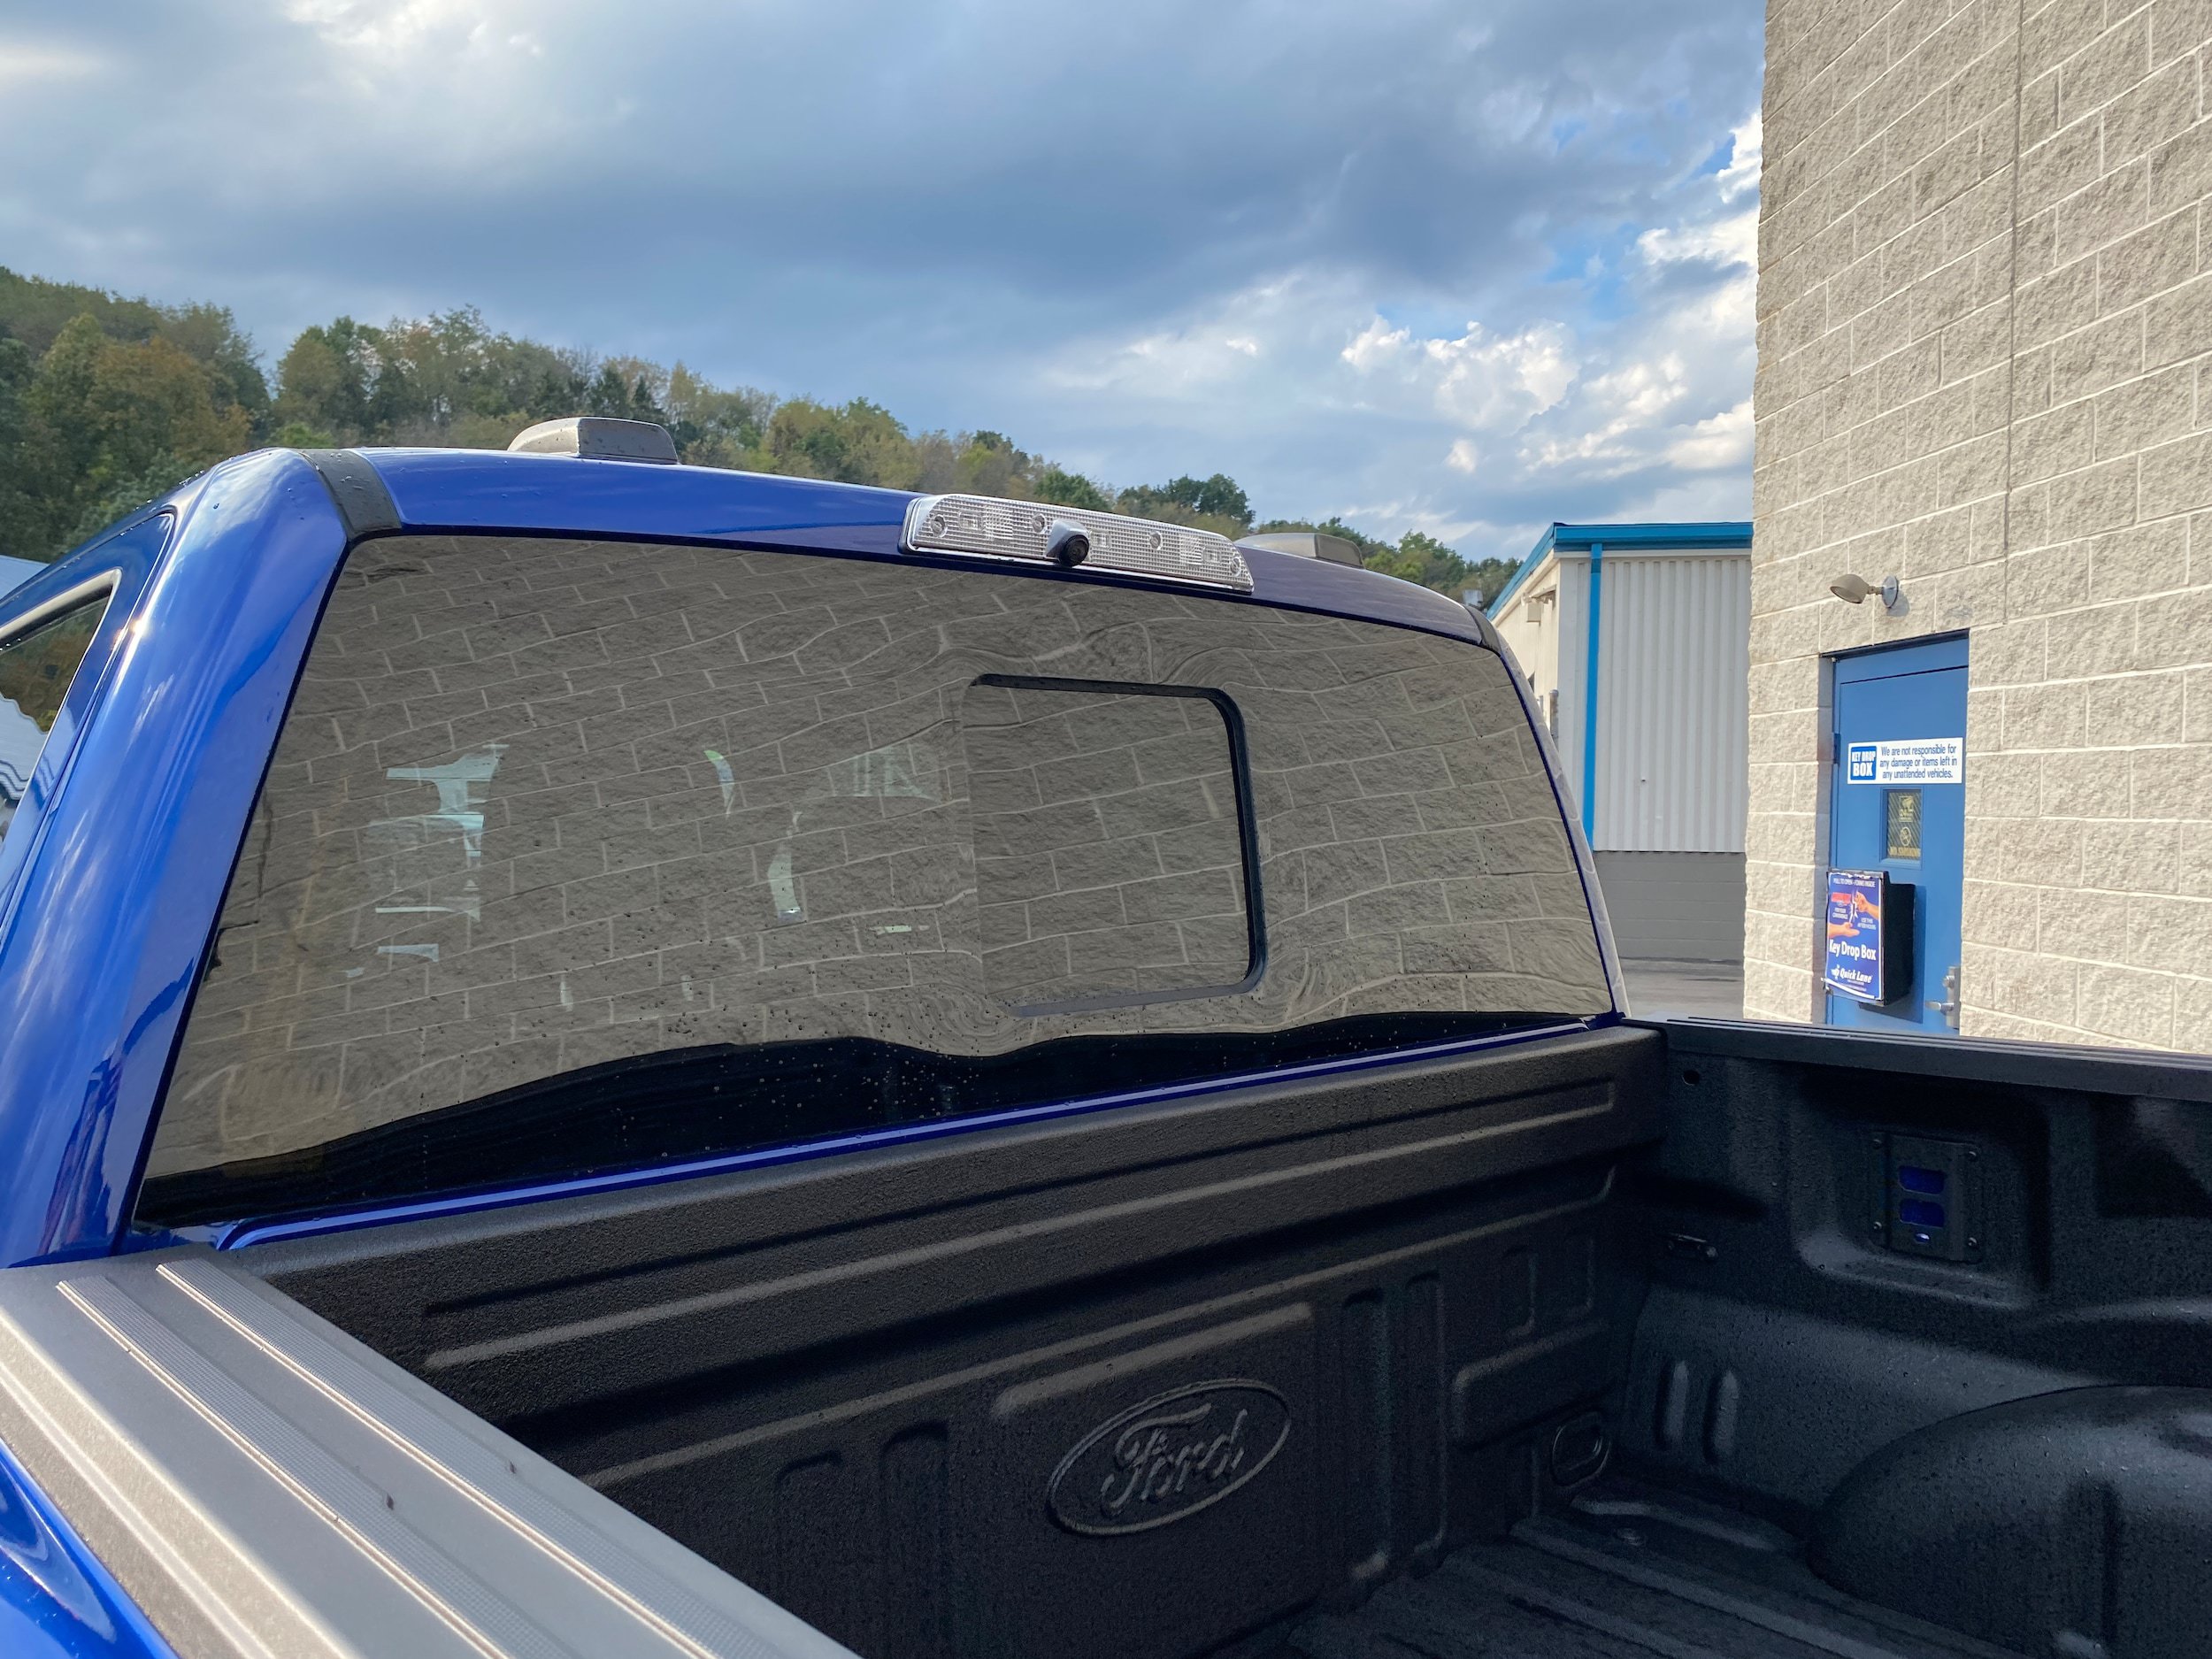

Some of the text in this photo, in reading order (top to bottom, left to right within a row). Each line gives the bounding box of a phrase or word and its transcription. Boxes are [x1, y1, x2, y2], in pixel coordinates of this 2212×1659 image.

[1852, 751, 1877, 762] KEY DROP
[1881, 743, 1957, 758] We are not responsible for
[1853, 762, 1873, 777] BOX
[1879, 759, 1889, 769] any
[1891, 758, 1913, 769] damage
[1922, 757, 1939, 766] items
[1939, 757, 1951, 765] left
[1951, 757, 1957, 765] in
[1882, 769, 1953, 780] any unattended vehicles.
[1829, 939, 1877, 961] Key Drop Box
[1839, 967, 1856, 980] Quick
[1856, 971, 1872, 983] Lane
[1100, 1402, 1248, 1517] Ford
